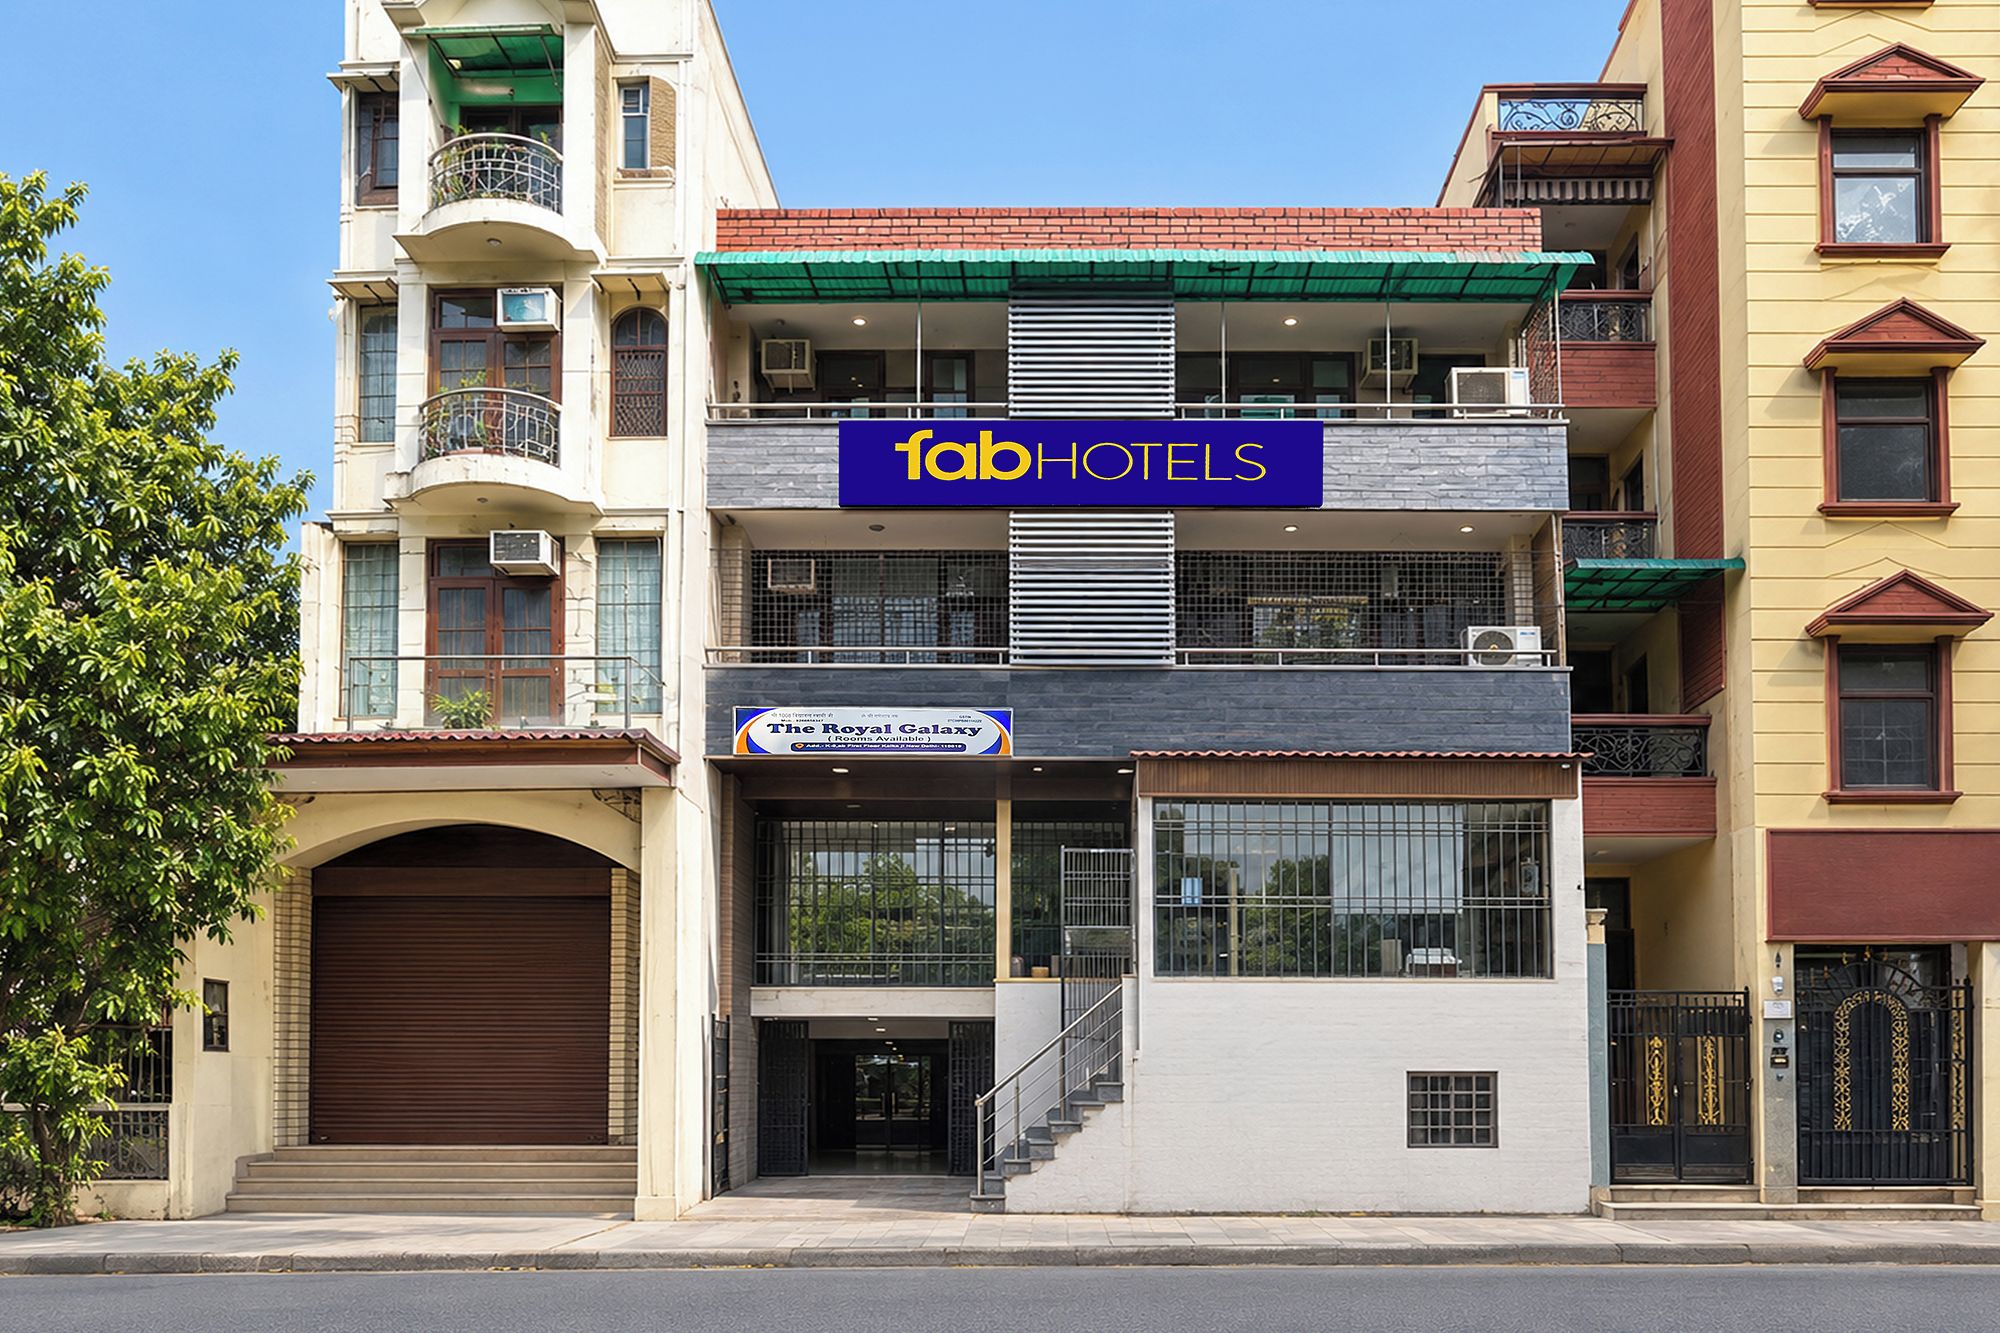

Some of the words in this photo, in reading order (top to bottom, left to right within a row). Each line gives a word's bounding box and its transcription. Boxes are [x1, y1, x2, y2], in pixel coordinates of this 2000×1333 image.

[767, 723, 815, 734] The
[821, 723, 892, 736] Royal
[898, 723, 983, 736] Galaxy
